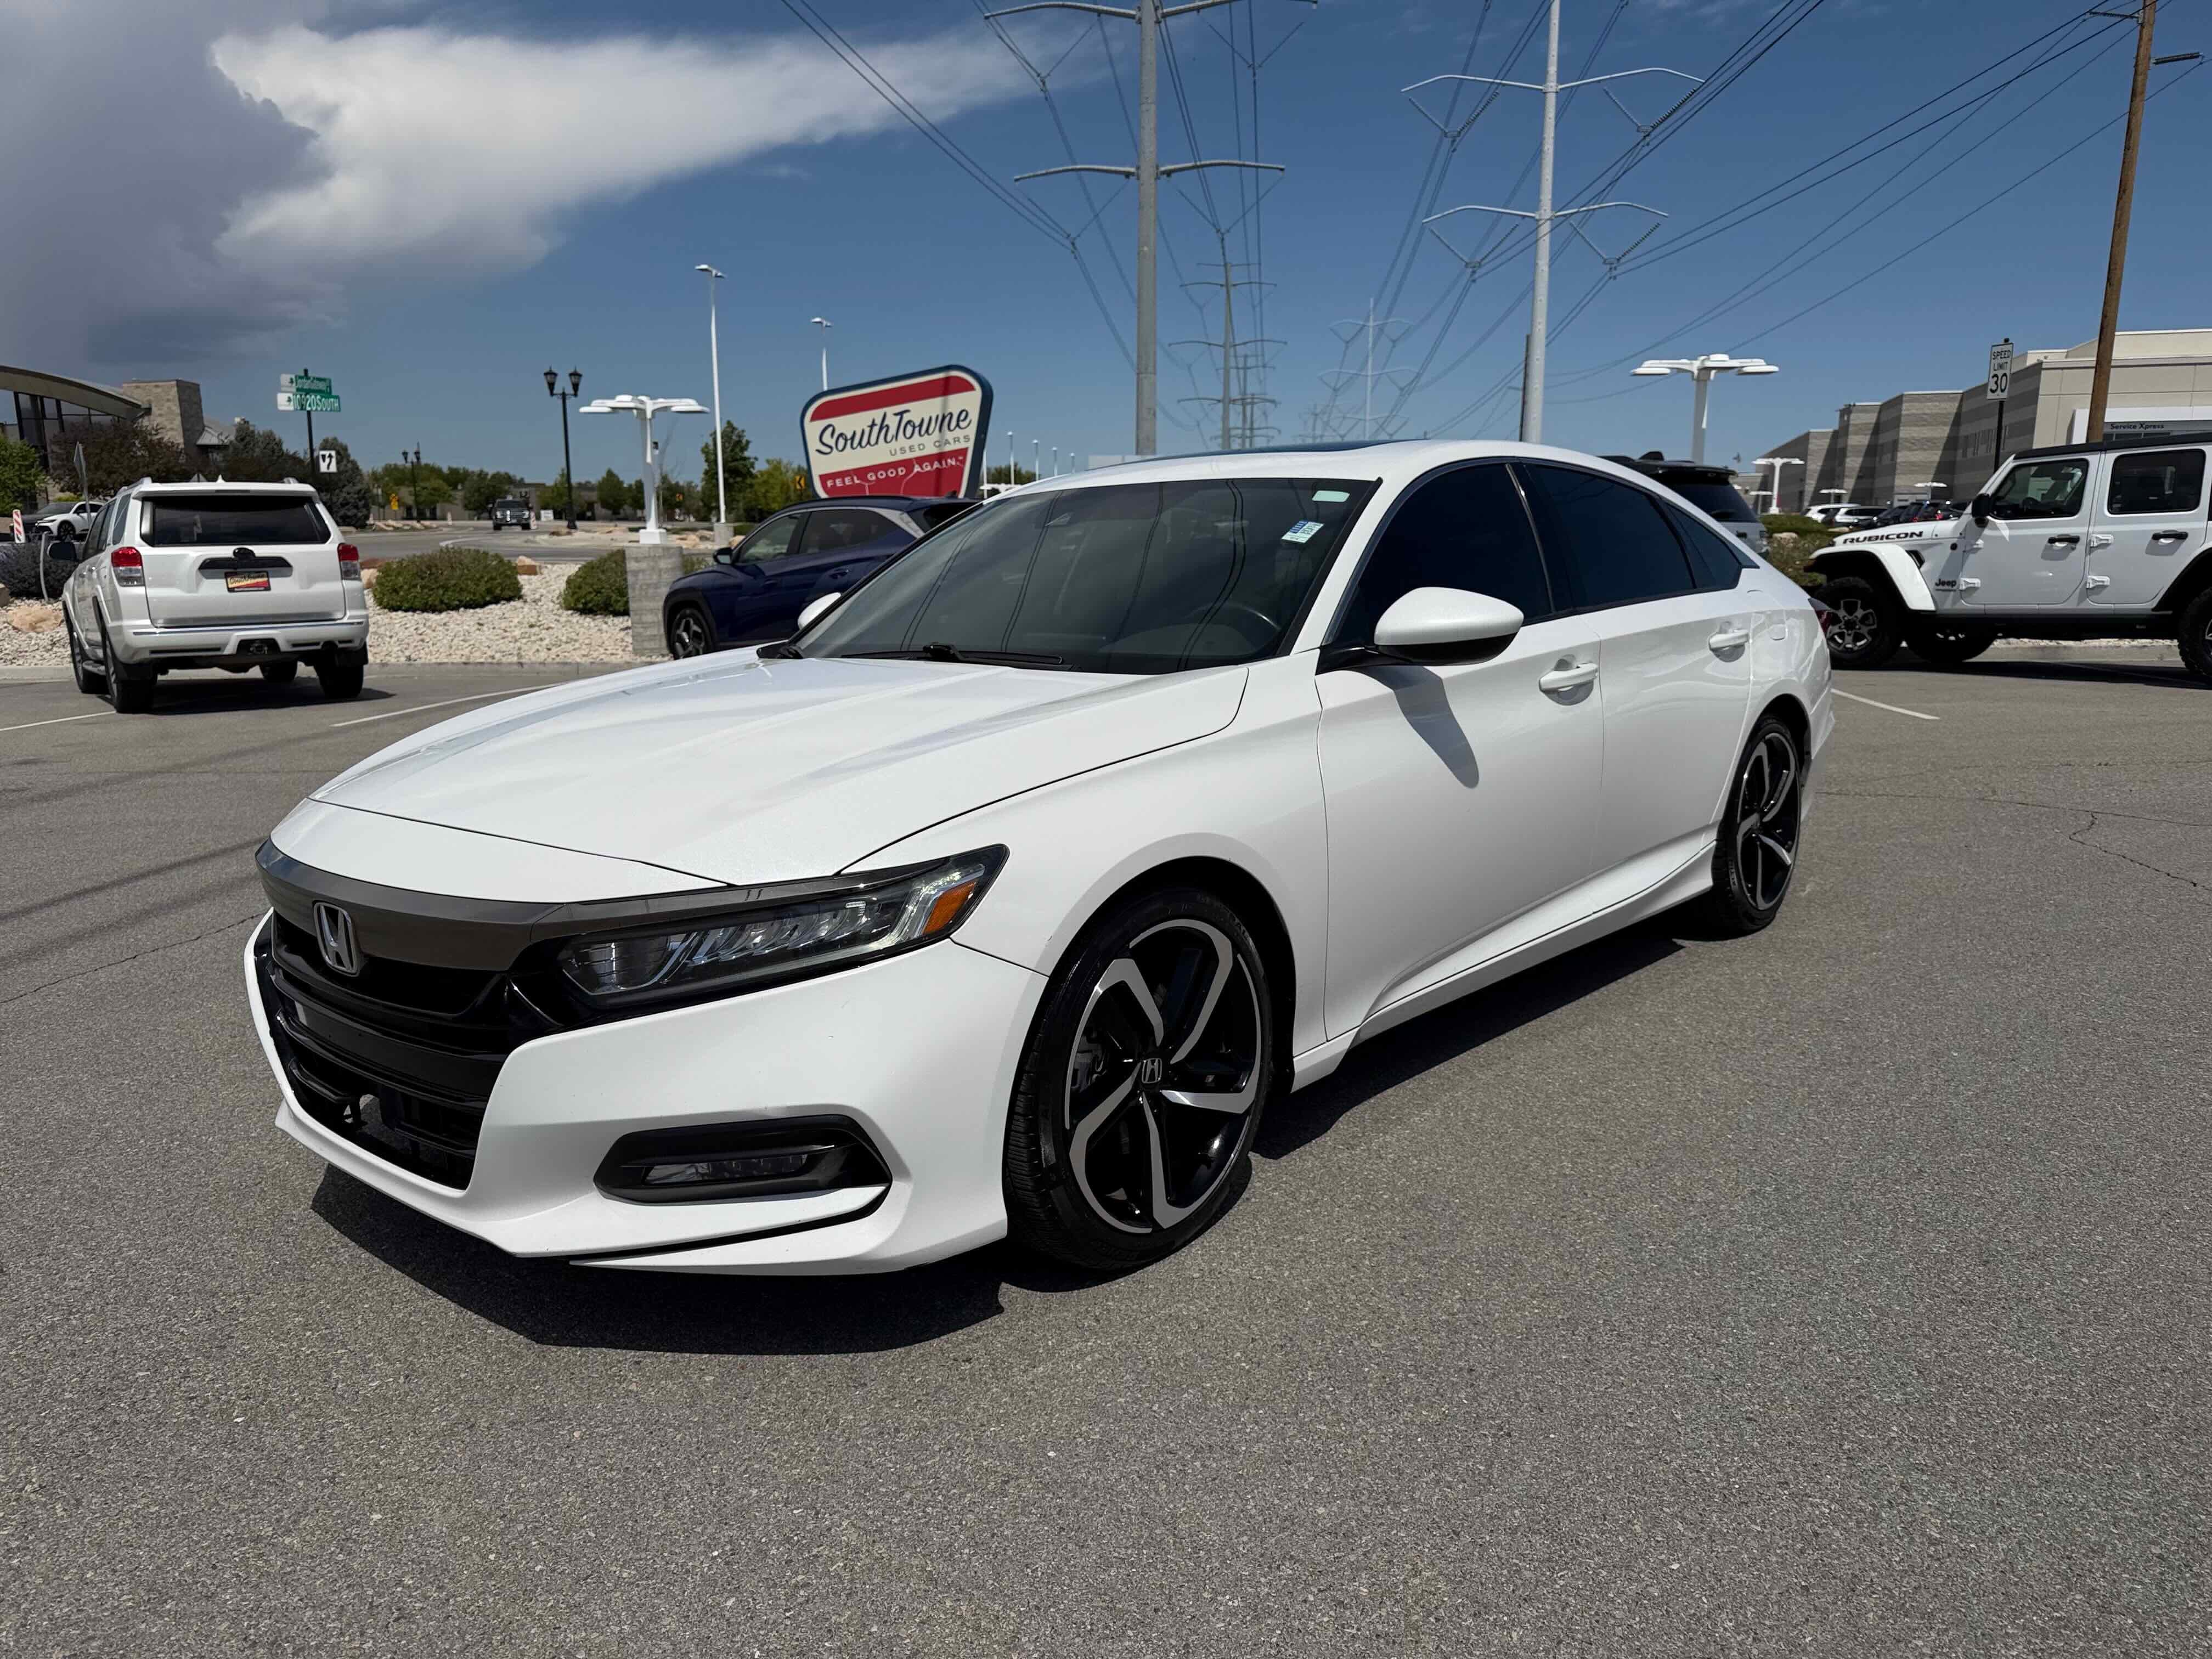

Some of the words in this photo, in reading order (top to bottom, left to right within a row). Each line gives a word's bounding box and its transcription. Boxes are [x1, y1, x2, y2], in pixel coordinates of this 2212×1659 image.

[1992, 350, 2010, 360] SPEED
[1993, 362, 2008, 371] LIMIT
[1990, 373, 2008, 393] 30
[815, 409, 972, 455] SouthTowne
[889, 443, 926, 456] USED
[933, 435, 970, 448] CARS
[826, 476, 861, 488] FEEL
[867, 466, 906, 481] GOOD
[1843, 531, 1923, 544] RUBICON
[1935, 579, 1957, 588] Jeep
